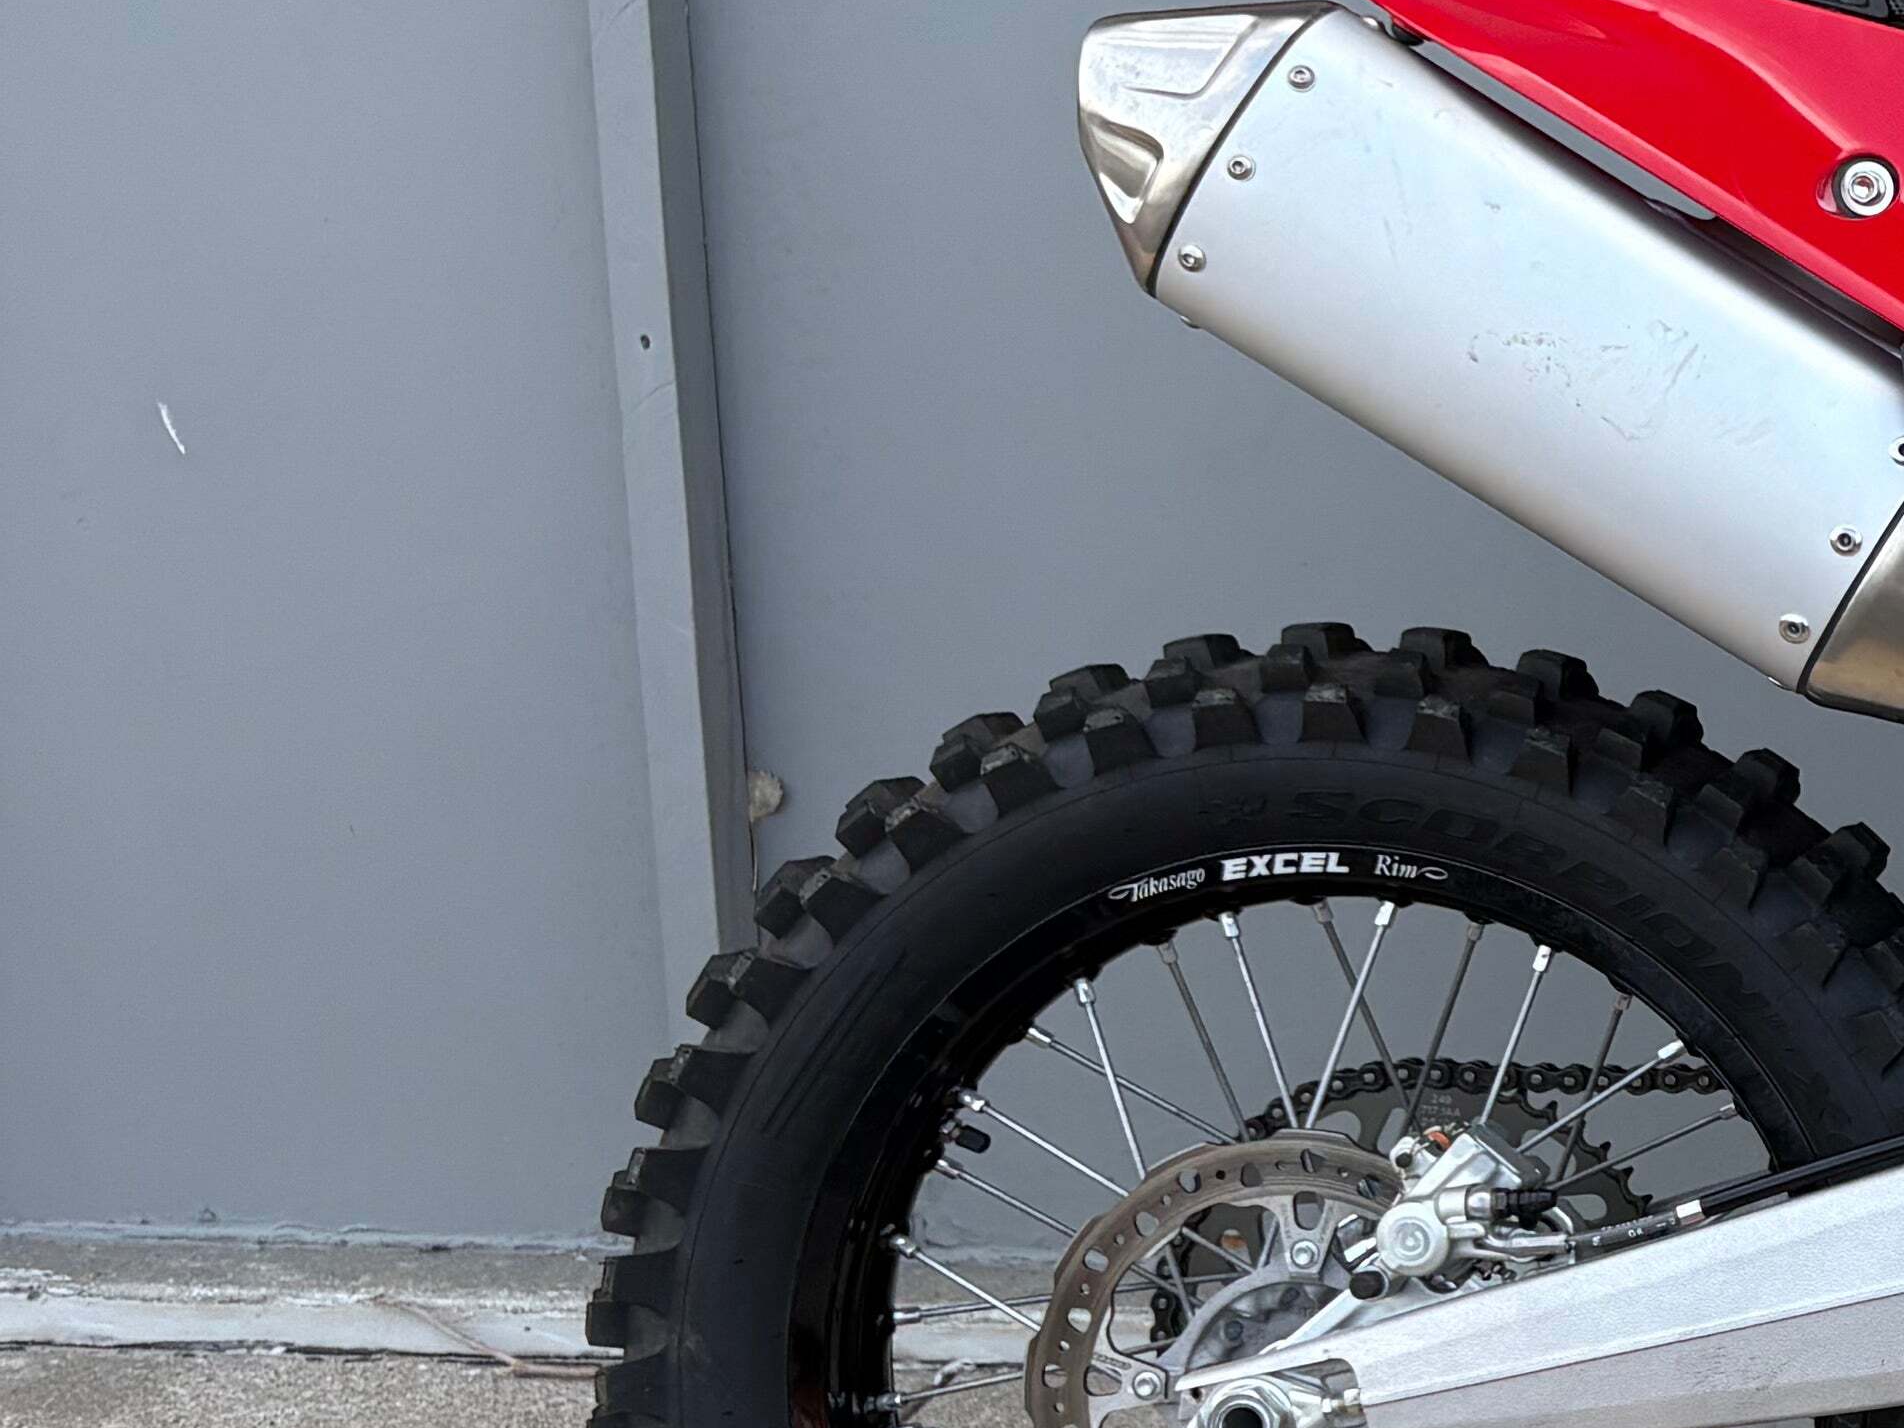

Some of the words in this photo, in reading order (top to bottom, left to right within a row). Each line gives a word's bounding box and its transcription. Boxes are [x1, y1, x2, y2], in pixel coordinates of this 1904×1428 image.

[1108, 867, 1206, 903] Takasago
[1220, 851, 1350, 881] EXCEL
[1374, 853, 1449, 881] Rim
